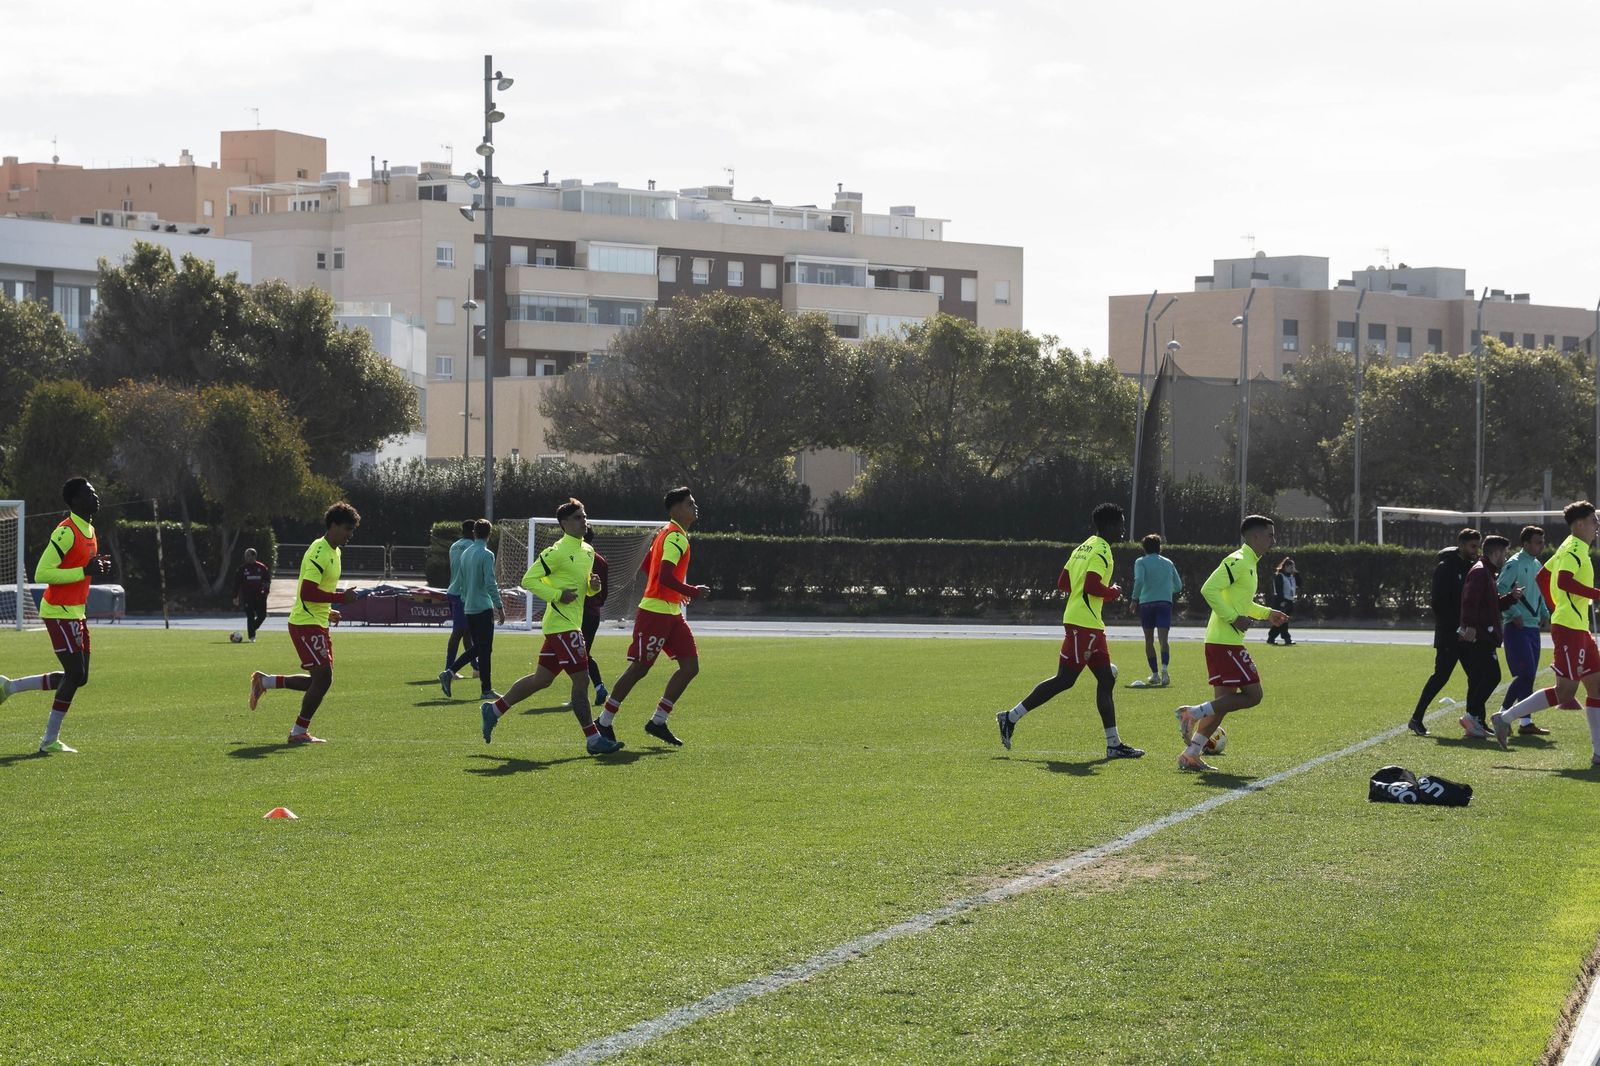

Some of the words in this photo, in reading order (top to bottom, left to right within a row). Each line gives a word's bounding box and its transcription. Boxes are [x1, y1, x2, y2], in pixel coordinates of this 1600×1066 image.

[68, 621, 81, 637] 12
[311, 635, 326, 650] 27
[646, 636, 665, 652] 29
[1088, 633, 1096, 650] 7
[1578, 648, 1586, 665] 9
